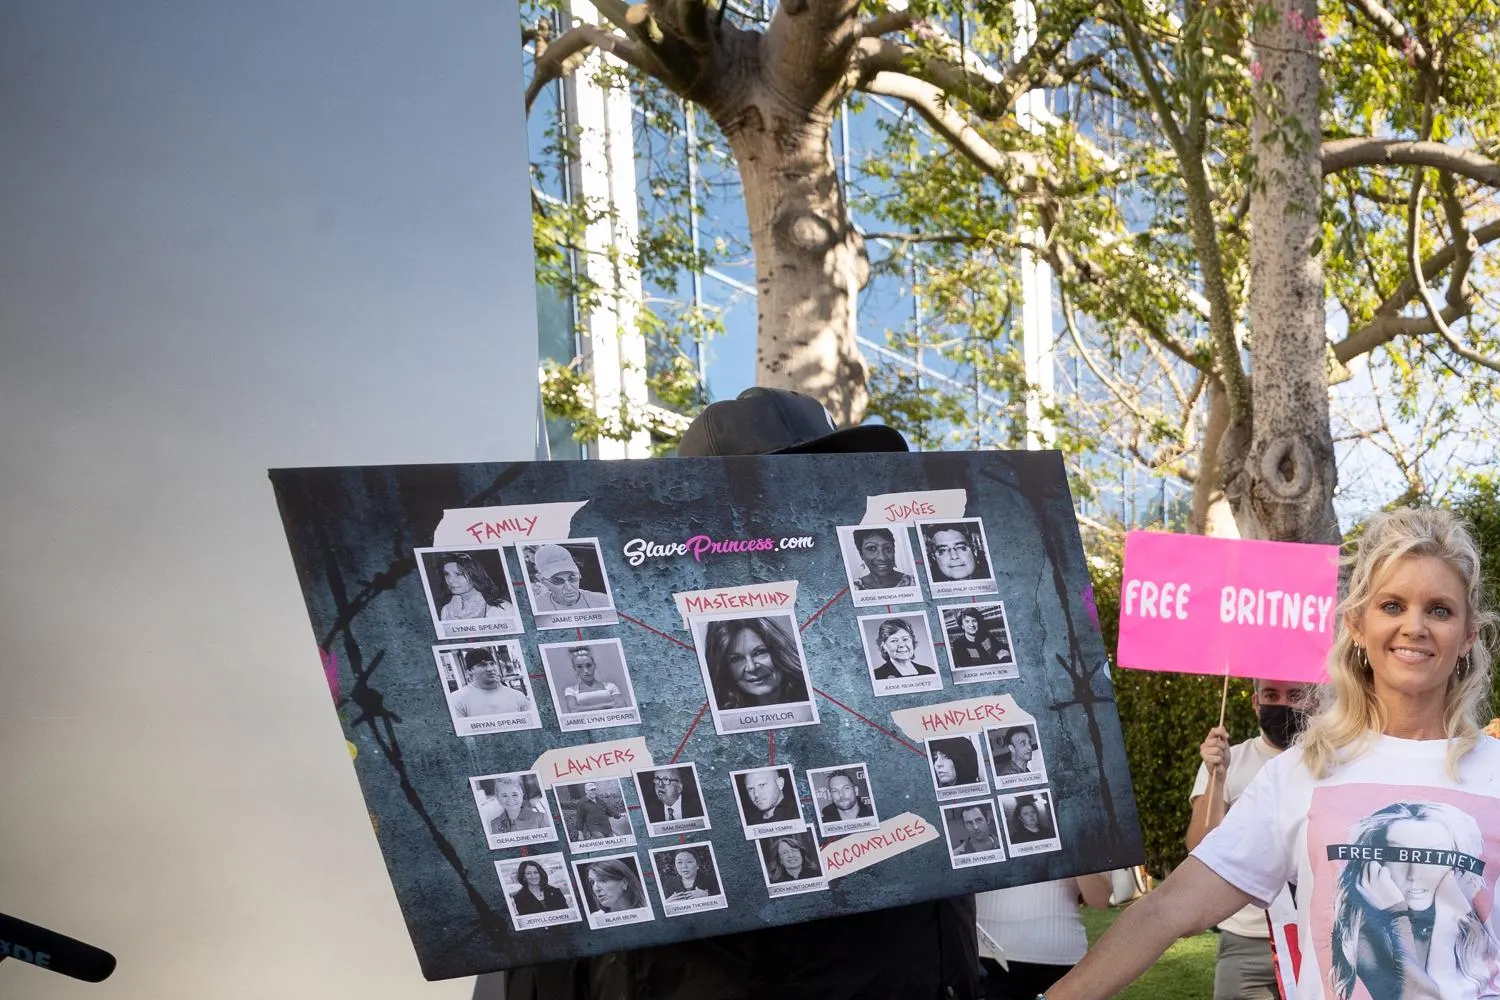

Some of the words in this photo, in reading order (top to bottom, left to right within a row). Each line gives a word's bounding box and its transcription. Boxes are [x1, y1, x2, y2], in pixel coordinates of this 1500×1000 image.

[884, 500, 936, 522] JUDGES
[466, 516, 538, 544] FAMILY
[623, 535, 815, 566] SlavePrincess.com
[685, 591, 790, 613] MASTERMIND
[1124, 579, 1191, 620] FREE
[1219, 585, 1333, 633] BRITNEY
[452, 625, 477, 633] LYNNE
[478, 622, 509, 632] SPEARS
[551, 615, 573, 624] JAMIE
[574, 614, 602, 622] SPEARS
[470, 721, 496, 730] BRYAN
[497, 717, 527, 727] SPEARS
[565, 718, 586, 726] JAMIE
[587, 716, 606, 724] LYNN
[606, 712, 635, 722] SPEARS
[739, 715, 760, 725] LOU
[761, 711, 794, 723] TAYLOR
[922, 703, 1006, 732] HANDLERS
[554, 748, 636, 778] LAWYERS
[579, 840, 605, 849] ANDREW
[605, 837, 627, 845] WALLET
[826, 820, 926, 870] ACCOMPLICES
[1338, 846, 1384, 861] FREE
[1399, 849, 1477, 871] BRITNEY
